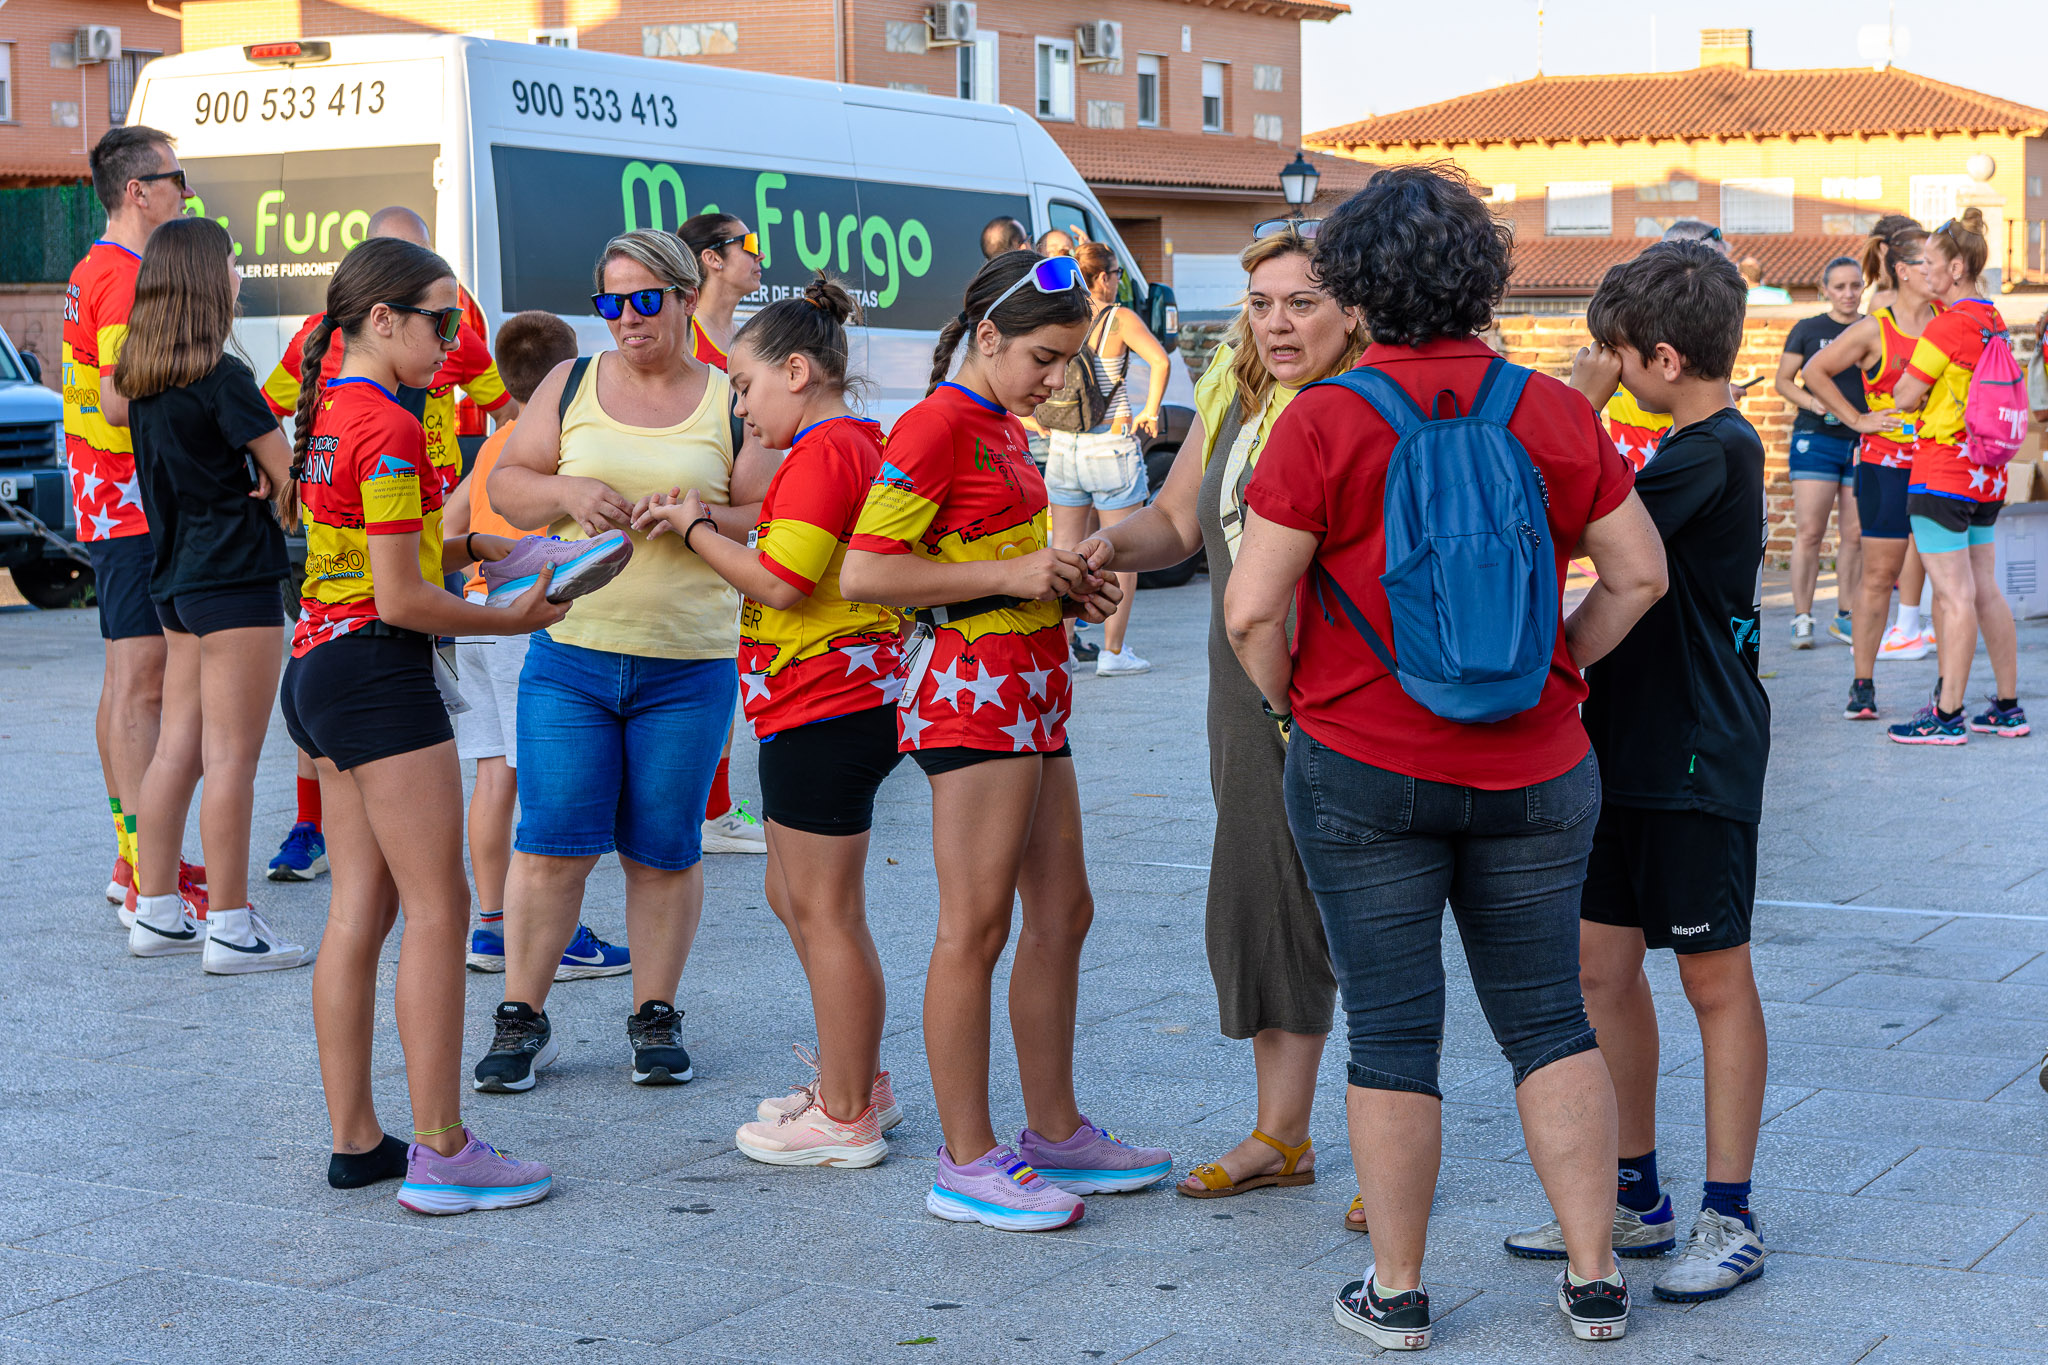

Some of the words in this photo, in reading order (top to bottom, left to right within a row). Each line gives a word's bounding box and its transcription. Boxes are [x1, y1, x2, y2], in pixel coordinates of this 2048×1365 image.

[195, 90, 249, 126] 900
[261, 86, 316, 122] 533
[328, 80, 385, 117] 413
[512, 80, 563, 117] 900
[574, 86, 622, 123] 533
[631, 92, 678, 129] 413
[755, 172, 933, 309] Furgo
[263, 263, 279, 278] DE
[280, 261, 340, 277] FURGONET
[772, 285, 789, 300] DE
